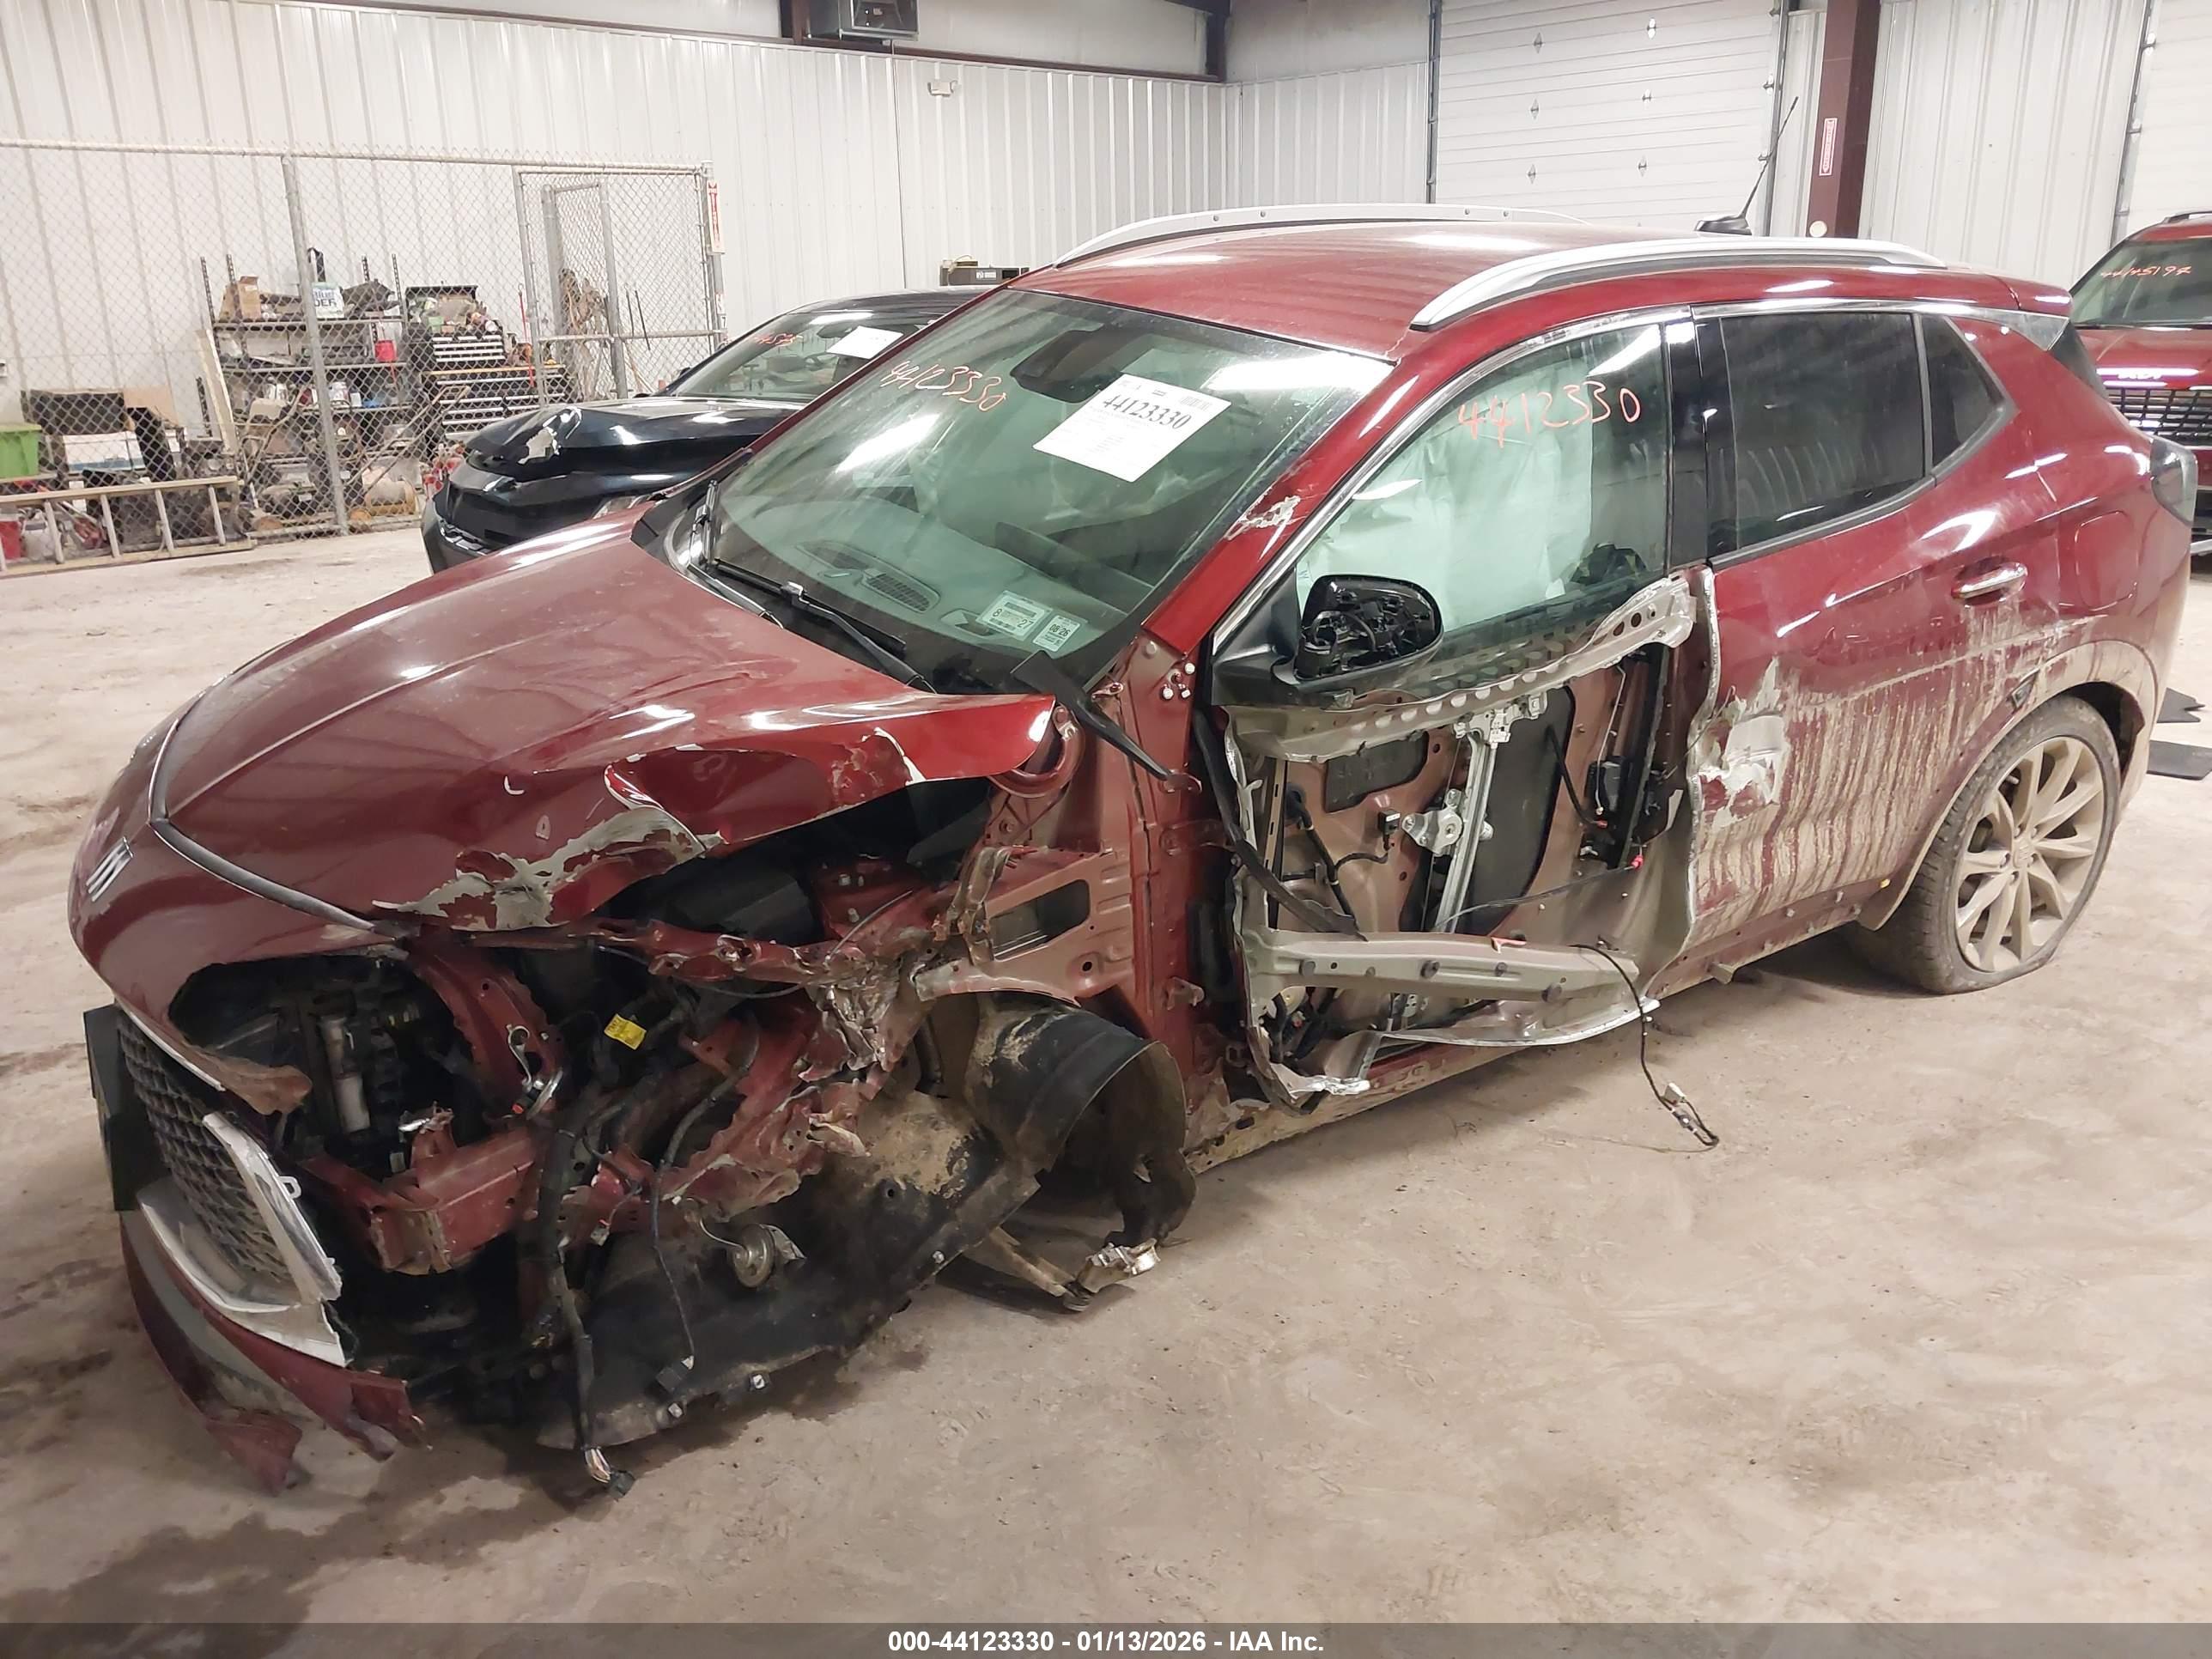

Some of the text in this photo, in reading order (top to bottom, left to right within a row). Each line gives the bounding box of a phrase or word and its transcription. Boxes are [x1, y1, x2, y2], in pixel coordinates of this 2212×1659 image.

[1103, 394, 1192, 429] 44123330
[992, 608, 1003, 617] 8
[1017, 618, 1035, 629] 27
